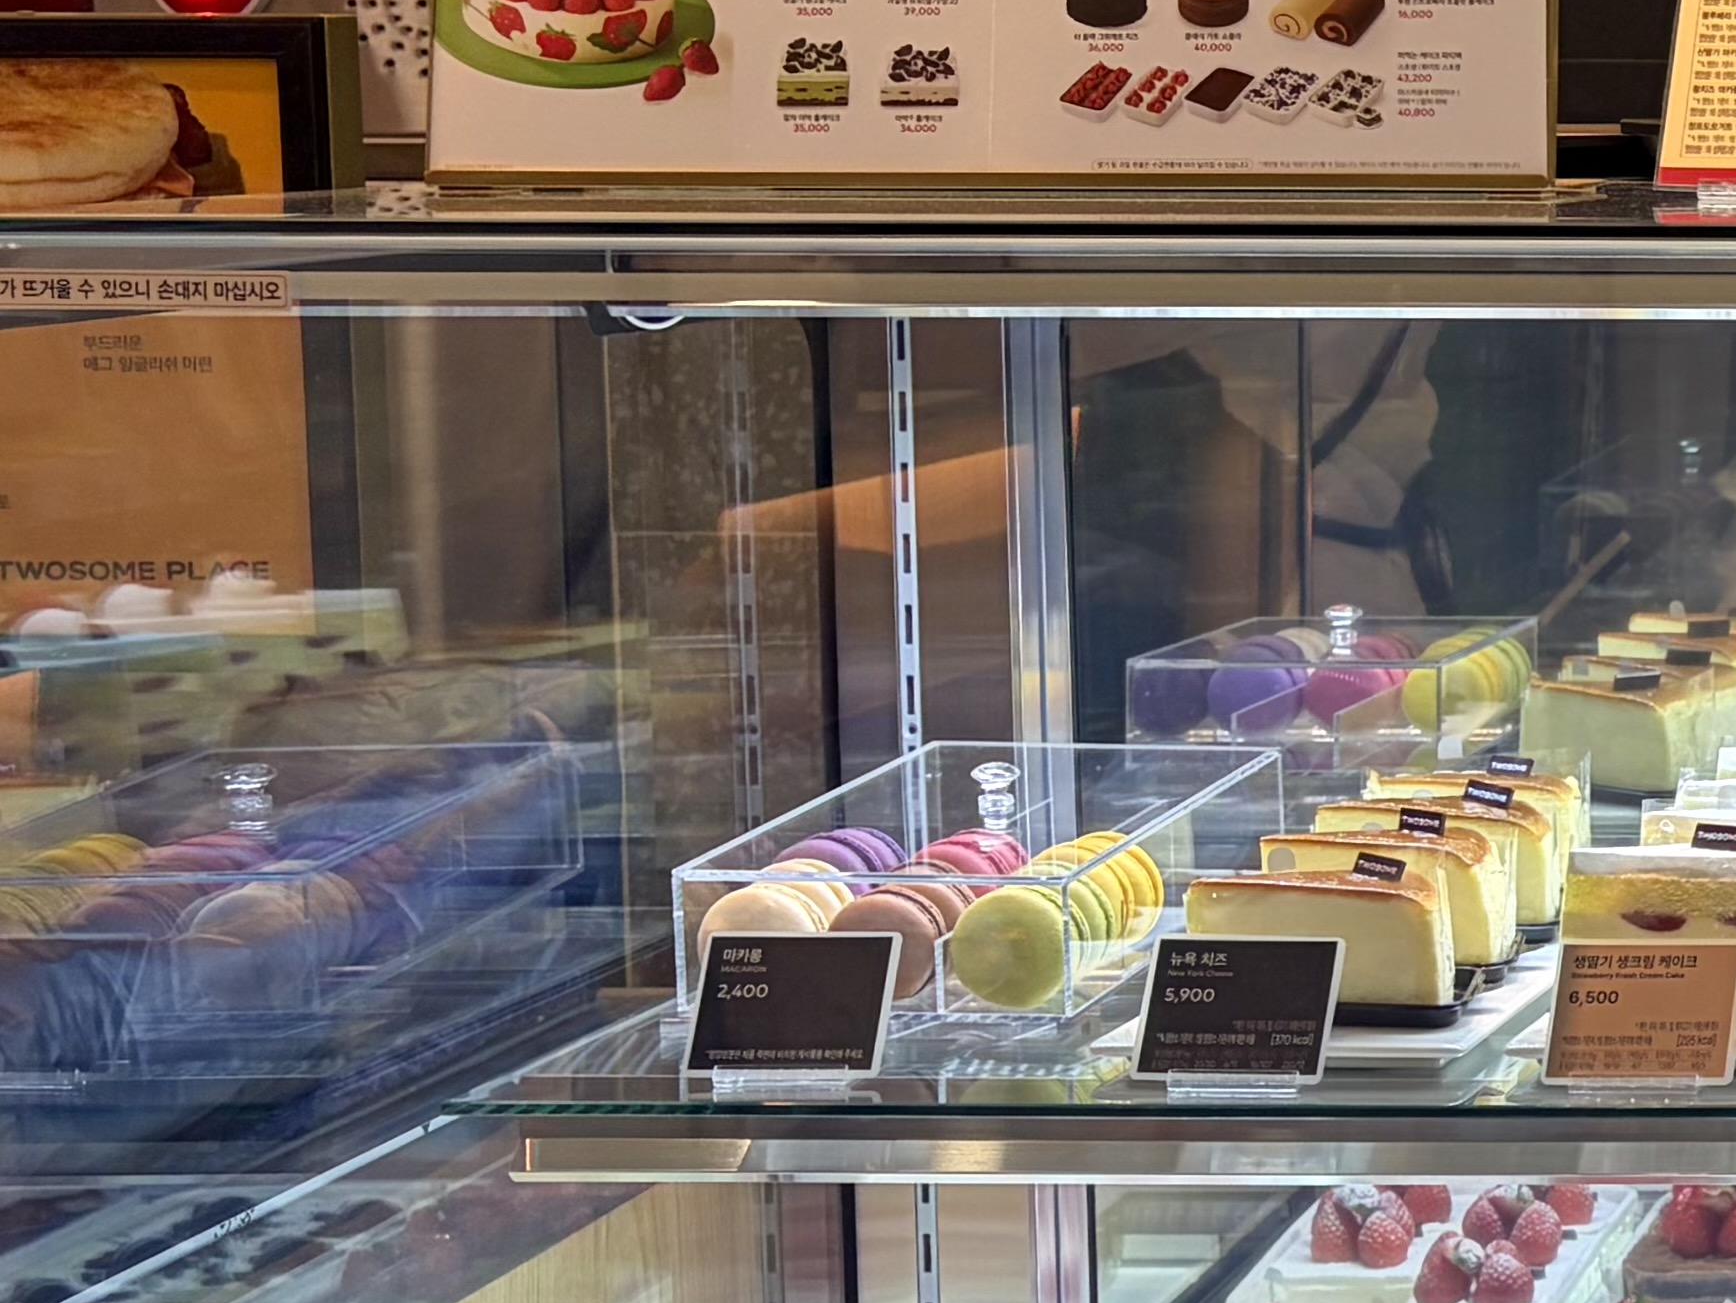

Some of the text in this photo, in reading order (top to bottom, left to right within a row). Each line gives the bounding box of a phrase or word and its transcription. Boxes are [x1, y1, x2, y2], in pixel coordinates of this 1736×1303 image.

[22, 279, 71, 298] 뜨거울
[77, 279, 95, 299] 수
[102, 279, 150, 299] 있으니
[157, 280, 208, 301] 손대지
[213, 281, 282, 302] 마십시오
[83, 335, 142, 351] 부드러운
[0, 560, 269, 581] TWOSOME PLACE
[723, 948, 763, 963] 마카롱
[1169, 951, 1228, 967] 뉴욕 치즈
[1573, 954, 1698, 969] 생딸기 생크림 케이크
[717, 983, 769, 1000] 2,400
[1164, 987, 1216, 1003] 5,900
[1568, 990, 1620, 1007] 6,500
